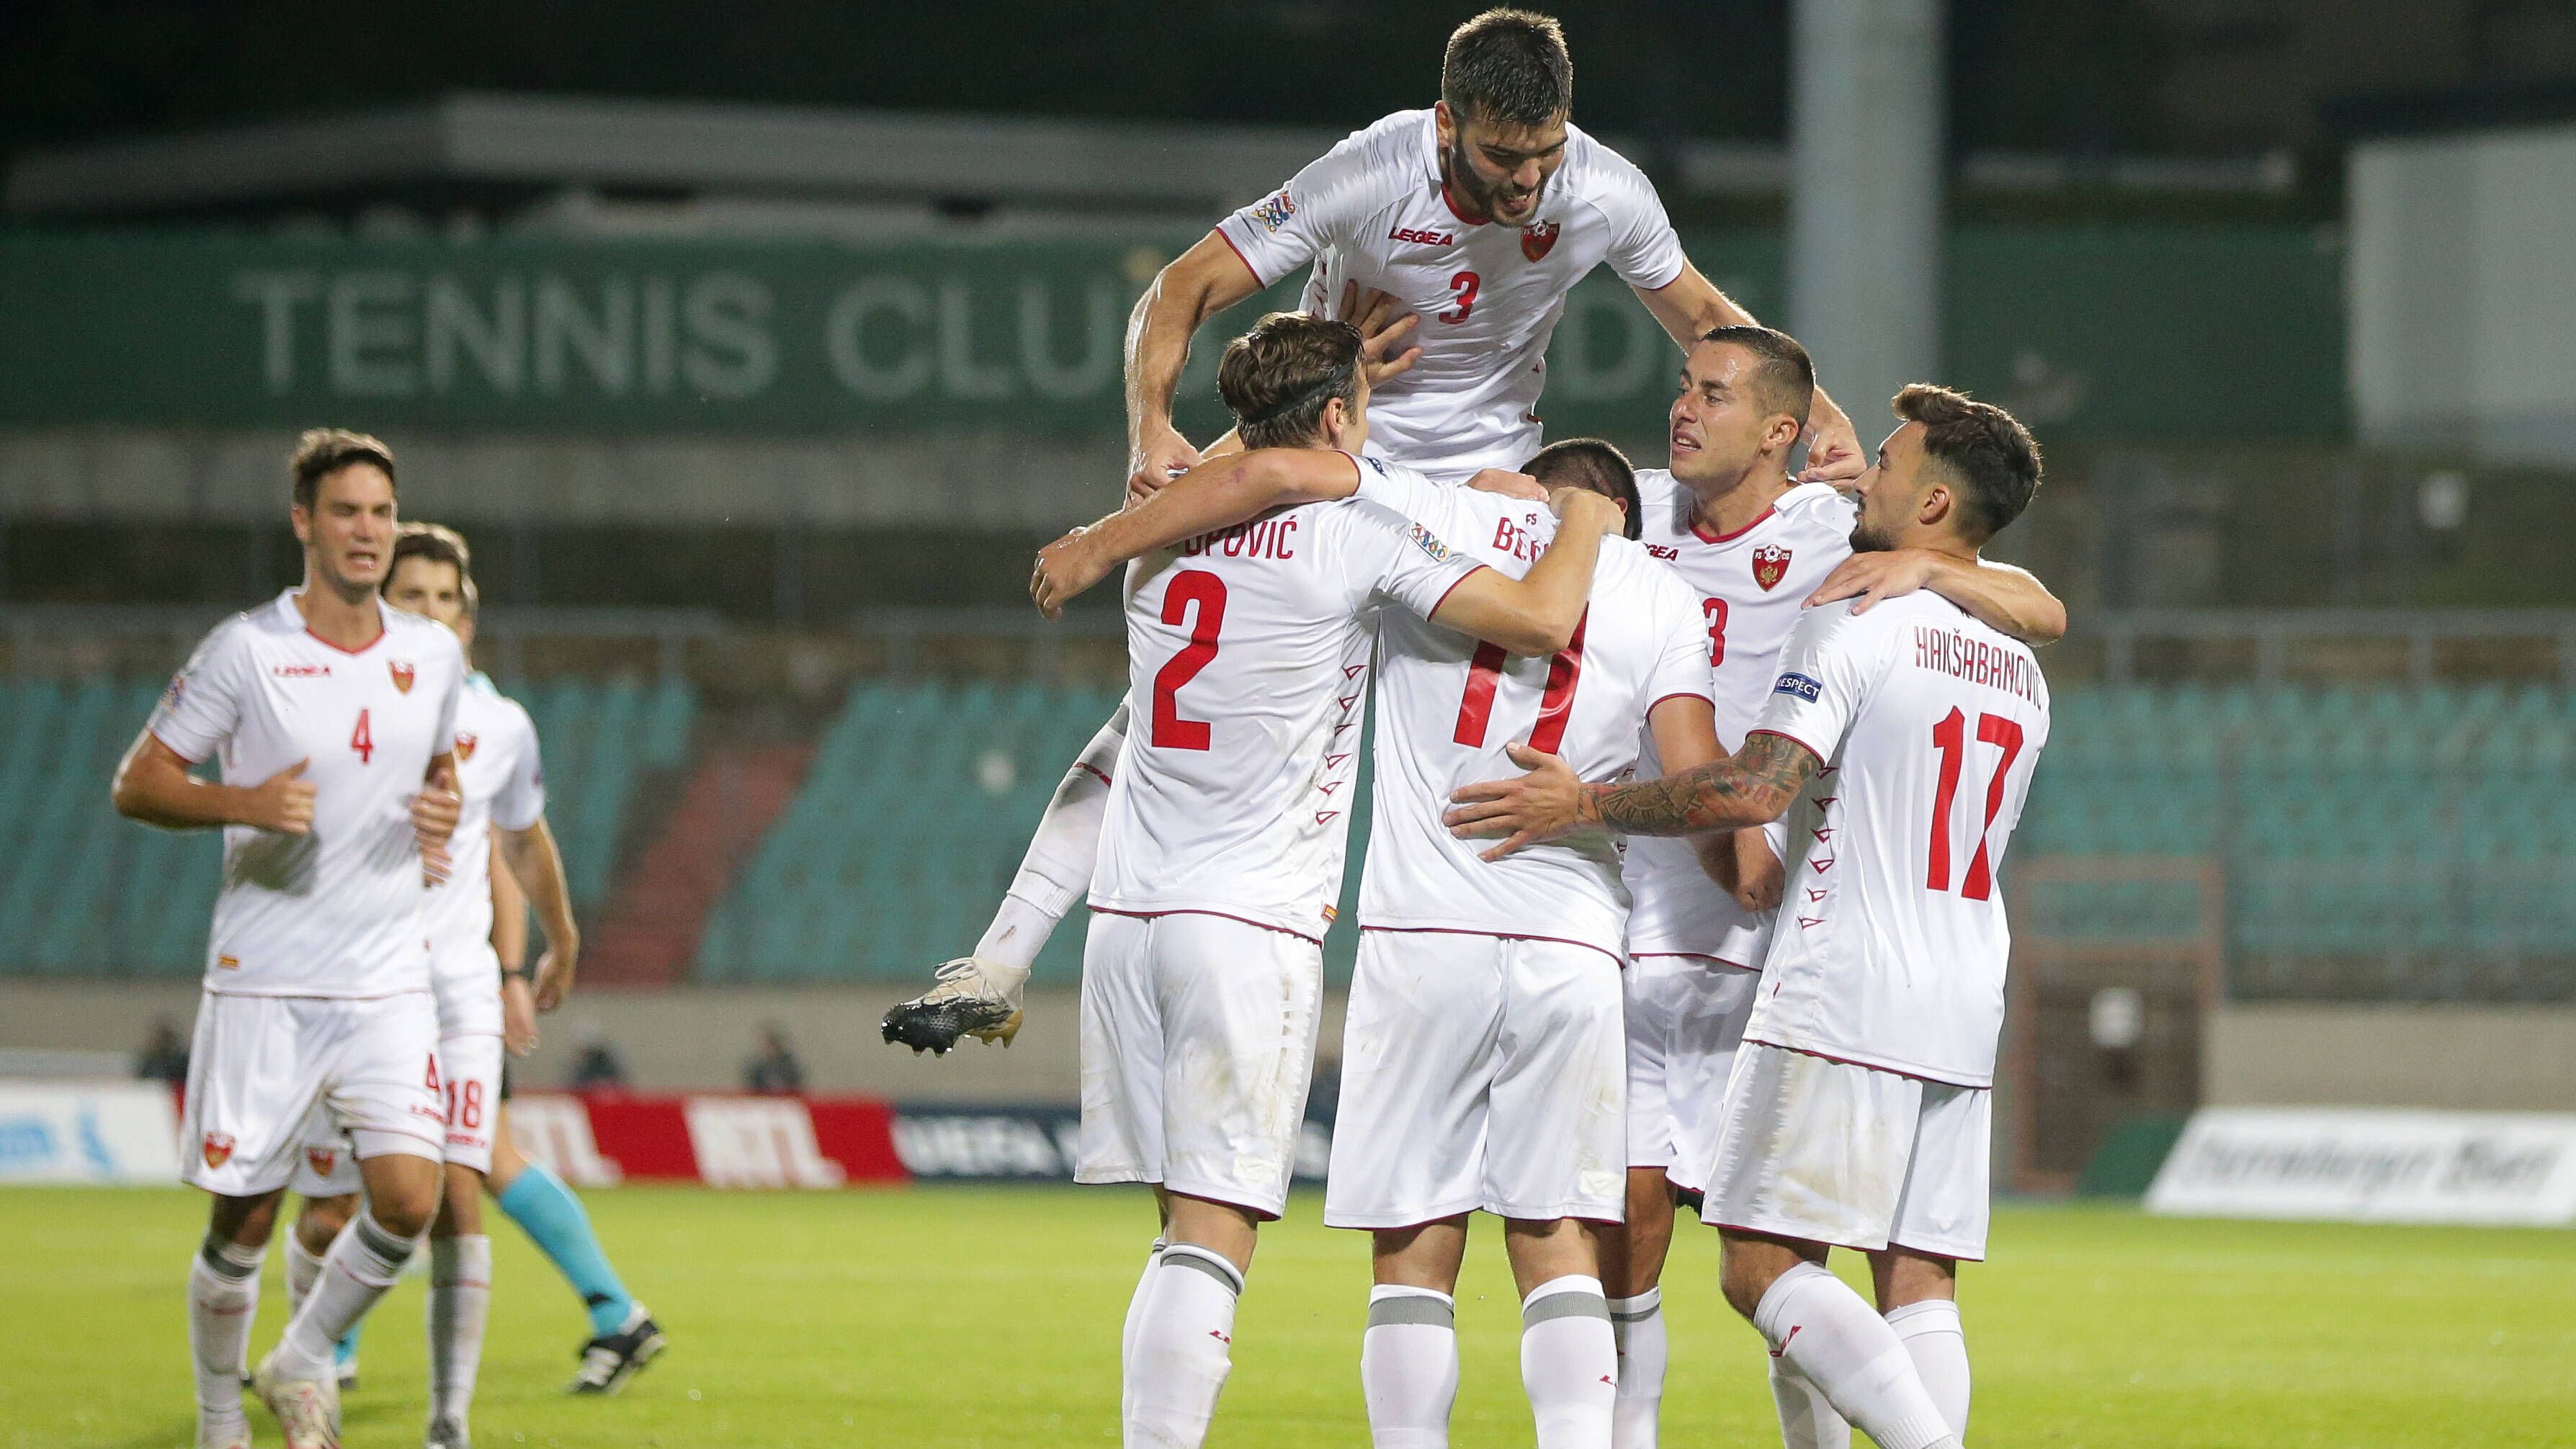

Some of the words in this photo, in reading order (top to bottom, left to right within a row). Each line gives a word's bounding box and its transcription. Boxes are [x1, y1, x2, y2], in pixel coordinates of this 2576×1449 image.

[1388, 227, 1453, 246] LEGEA
[1439, 272, 1481, 324] 3
[234, 268, 779, 398] TENNIS
[1183, 515, 1297, 560] OPOVIĆ
[1645, 544, 1680, 561] GEA
[1150, 570, 1227, 751] 2
[351, 709, 373, 764] 4
[1926, 705, 2024, 902] 17
[426, 1053, 441, 1102] 4
[447, 1079, 483, 1129] 18
